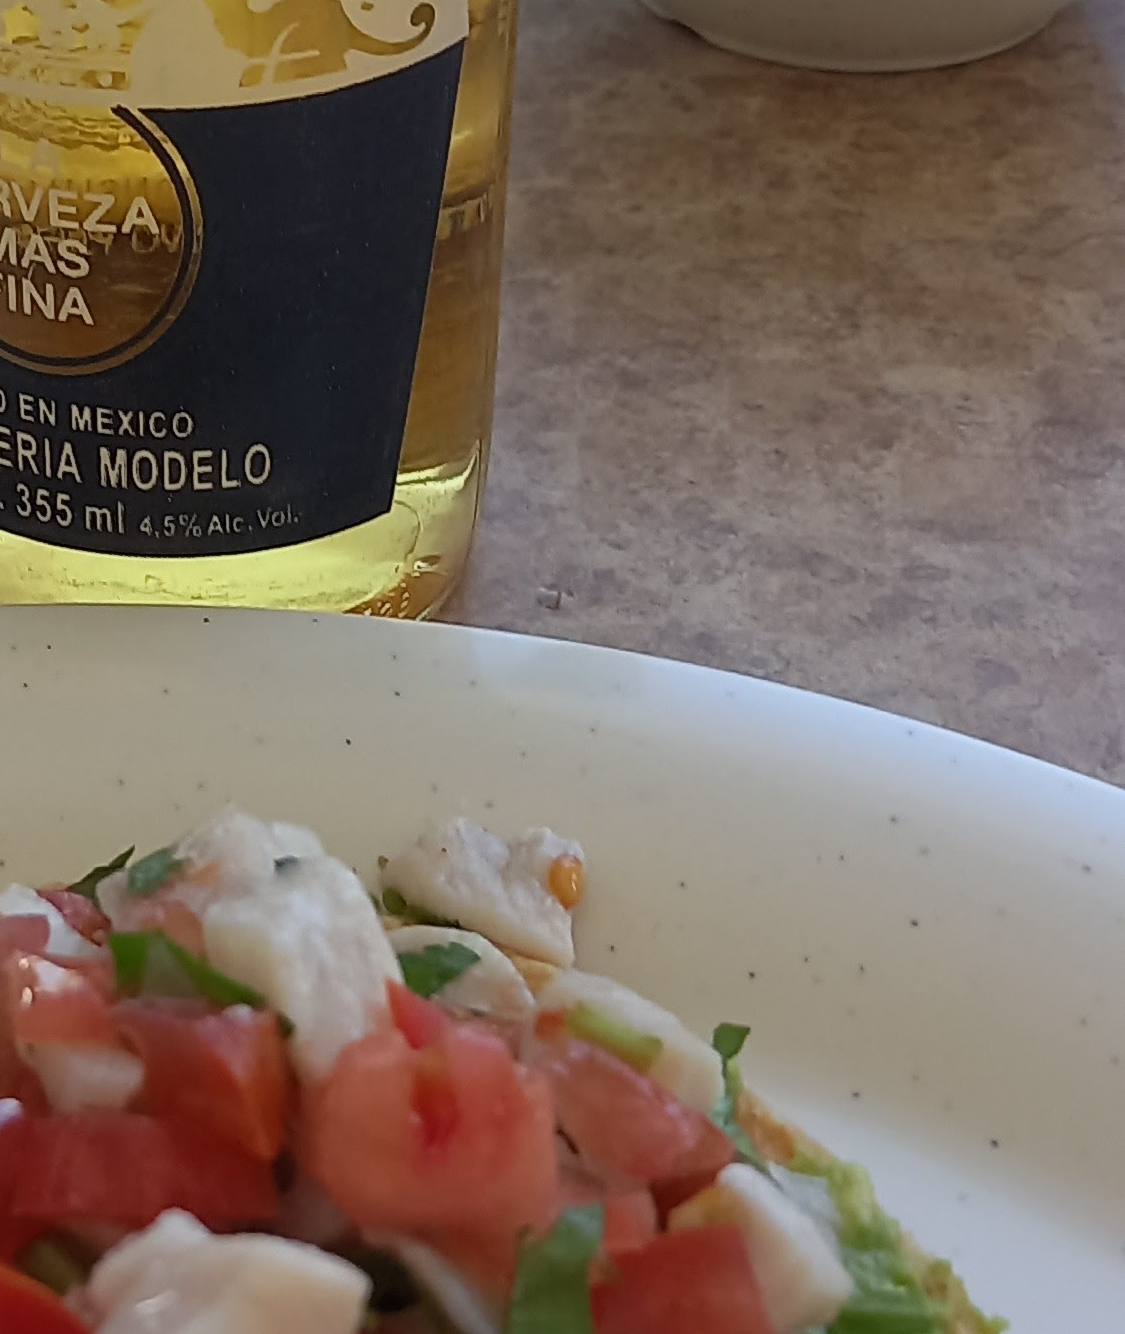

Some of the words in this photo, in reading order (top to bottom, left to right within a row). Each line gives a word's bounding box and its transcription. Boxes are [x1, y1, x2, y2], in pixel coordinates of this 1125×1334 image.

[19, 392, 57, 427] EN
[71, 403, 195, 439] MEXICO
[99, 442, 272, 491] MODELO
[16, 485, 73, 528] 355
[84, 501, 126, 535] ml
